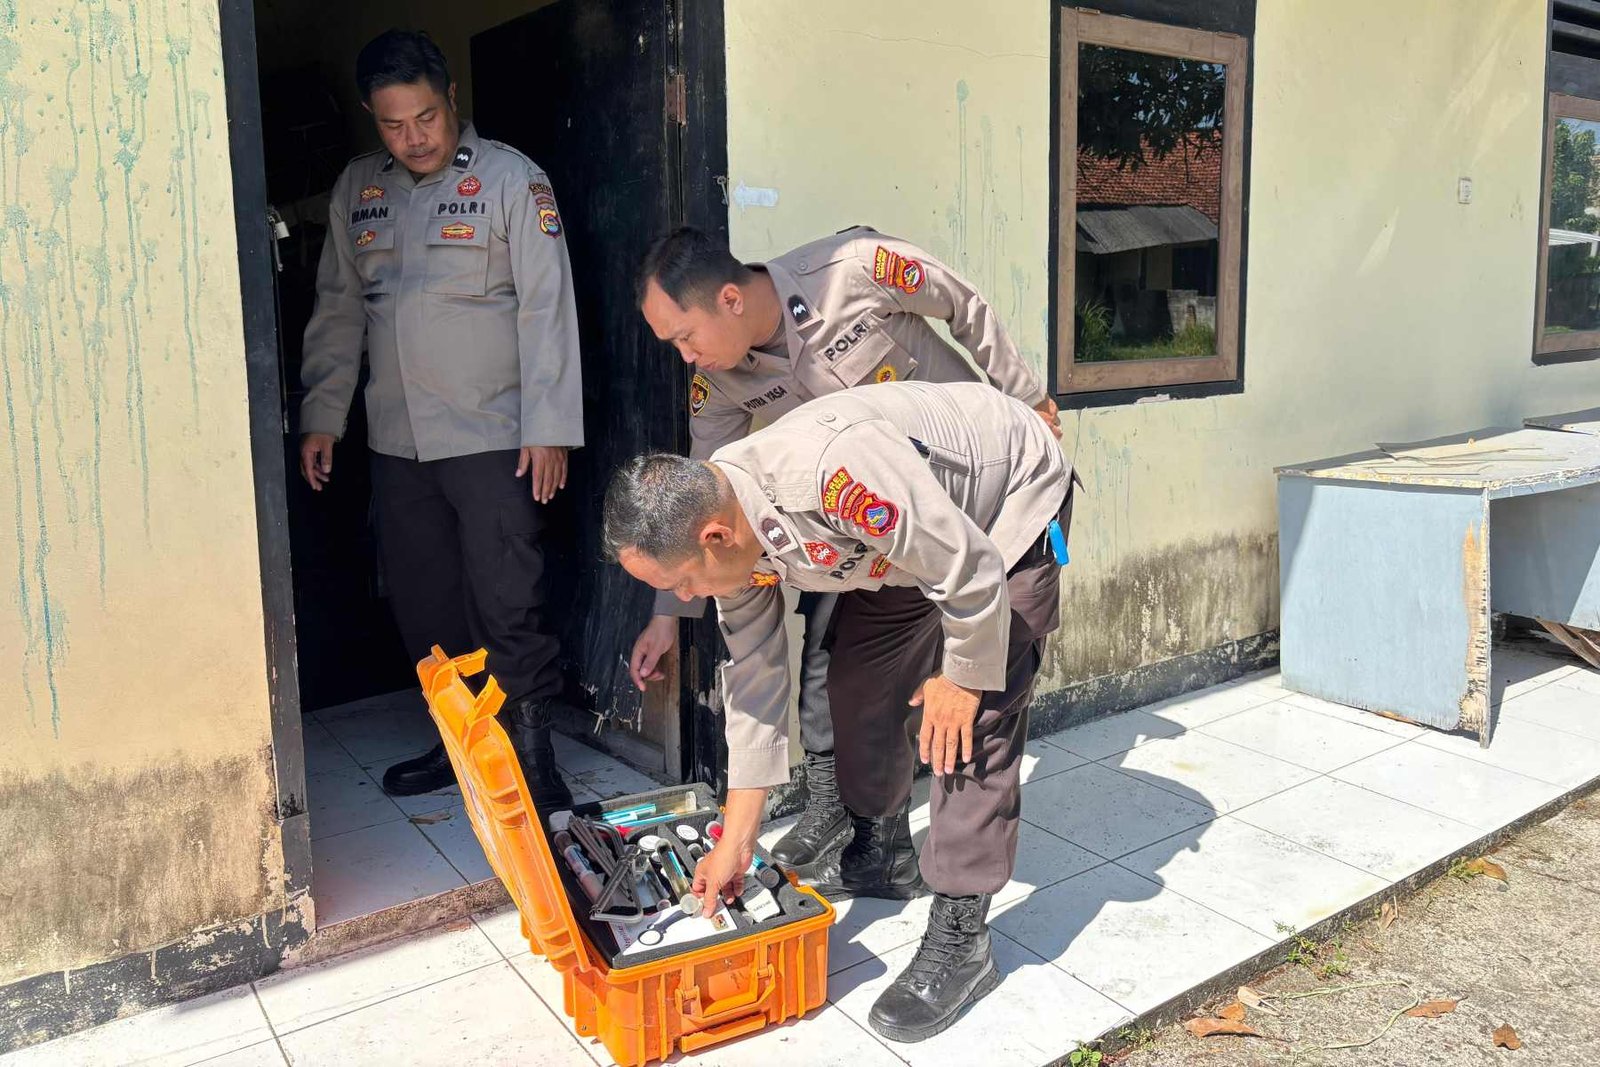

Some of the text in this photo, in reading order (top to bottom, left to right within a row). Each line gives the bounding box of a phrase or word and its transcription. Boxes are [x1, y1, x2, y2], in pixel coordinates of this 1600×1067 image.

[437, 202, 486, 216] POLRI
[824, 319, 870, 361] POLRI
[743, 385, 788, 410] PUTRA YASA
